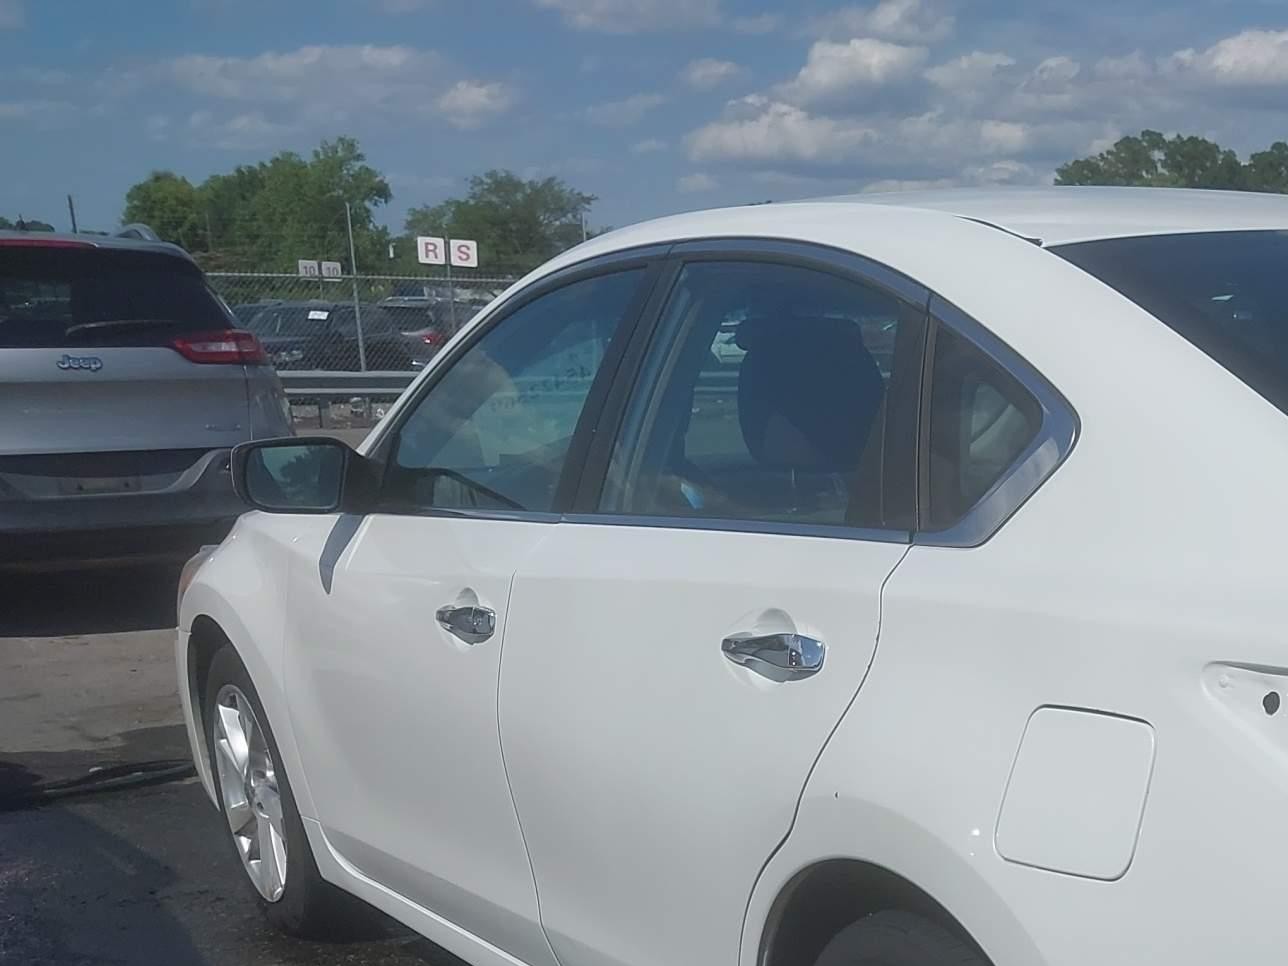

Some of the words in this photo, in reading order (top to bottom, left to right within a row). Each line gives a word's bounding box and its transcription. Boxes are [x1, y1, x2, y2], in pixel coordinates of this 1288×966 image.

[425, 241, 439, 259] R
[457, 244, 471, 262] S
[56, 354, 103, 372] Jeep
